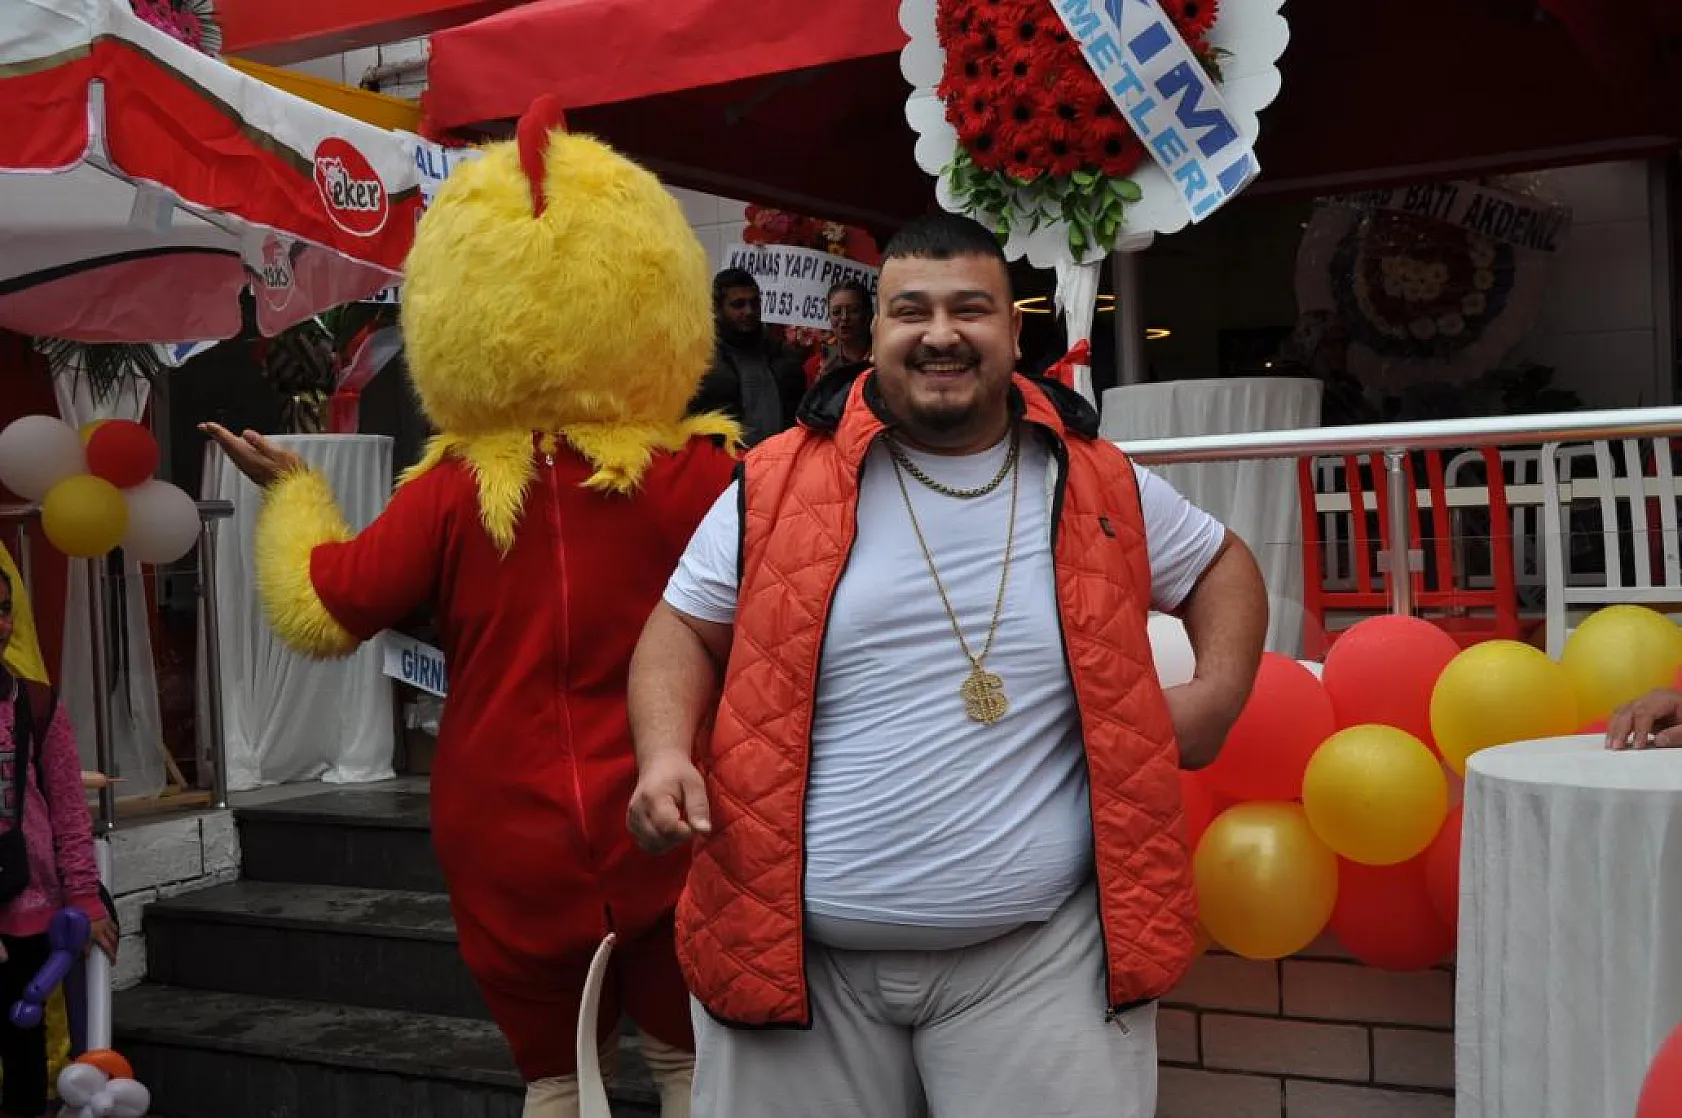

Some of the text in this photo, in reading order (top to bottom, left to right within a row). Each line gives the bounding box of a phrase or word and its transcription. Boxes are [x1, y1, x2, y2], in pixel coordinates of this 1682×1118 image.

[333, 171, 380, 209] eker
[785, 253, 819, 281] YAPI
[778, 291, 793, 316] 53
[802, 294, 829, 321] 053
[402, 643, 447, 692] GİRN
